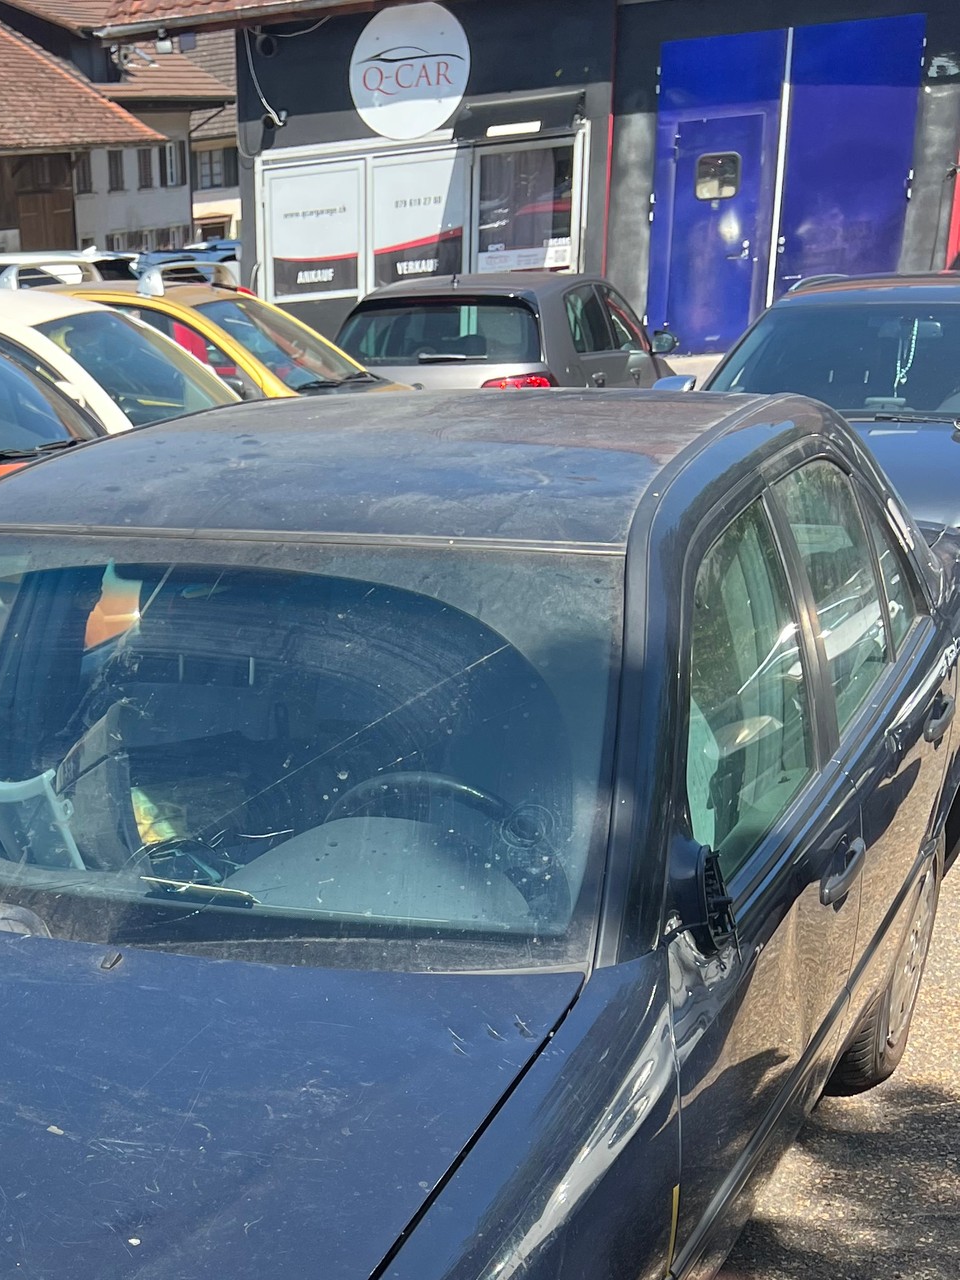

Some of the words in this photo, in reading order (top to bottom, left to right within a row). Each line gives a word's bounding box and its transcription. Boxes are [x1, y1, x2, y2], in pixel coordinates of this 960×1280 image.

[362, 61, 454, 96] Q-CAR
[396, 259, 440, 275] VERKAUF
[296, 268, 335, 284] ANKAUF
